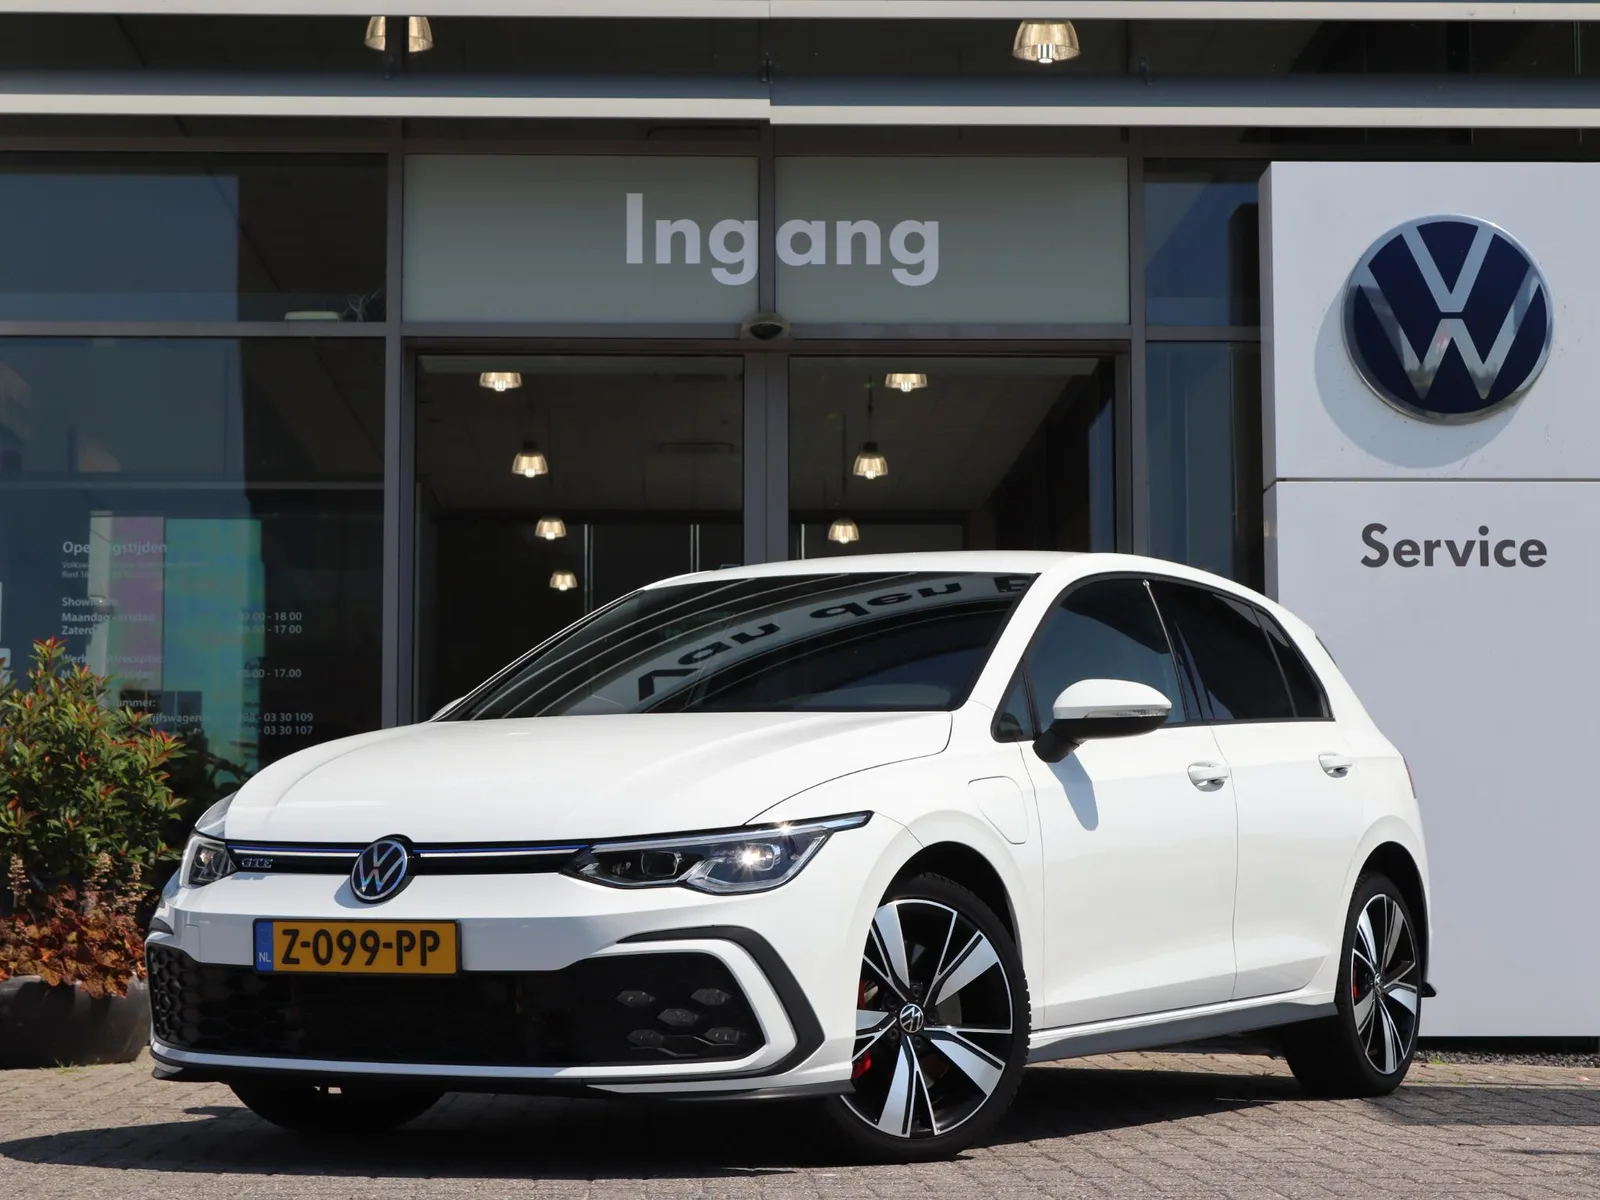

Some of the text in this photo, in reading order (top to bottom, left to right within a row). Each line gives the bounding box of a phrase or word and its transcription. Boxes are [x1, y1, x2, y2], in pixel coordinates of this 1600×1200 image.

[62, 540, 168, 556] Opegstijden
[1360, 522, 1548, 568] Service
[241, 857, 274, 869] GTE
[281, 928, 440, 967] Z-099-PP
[258, 952, 272, 963] NL
